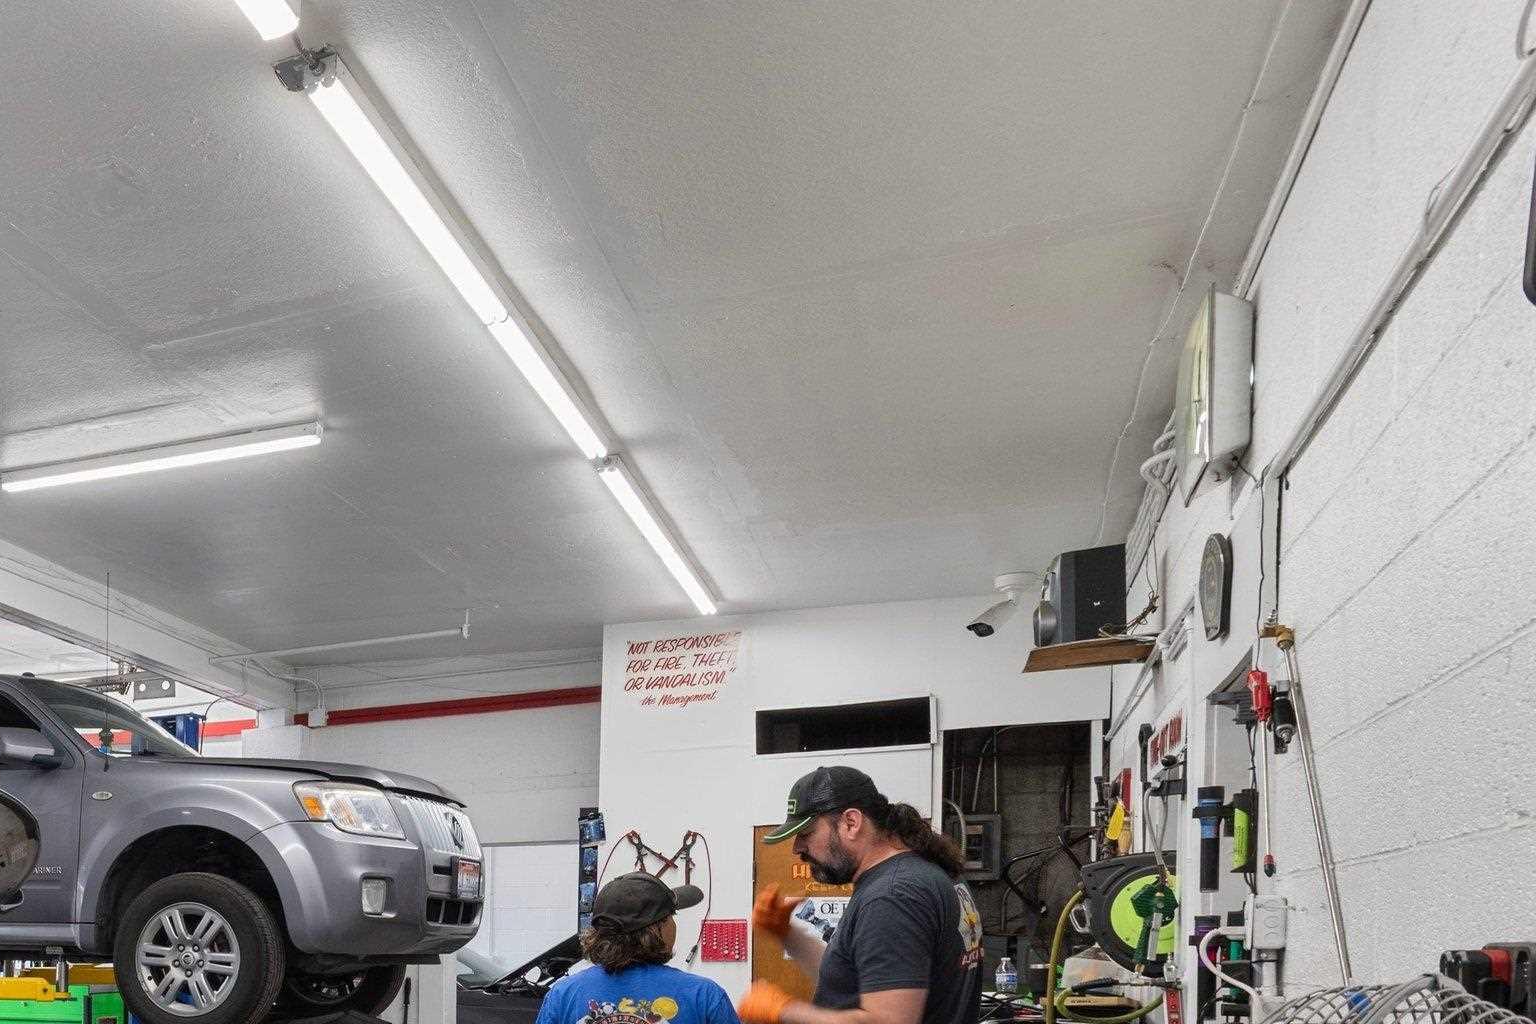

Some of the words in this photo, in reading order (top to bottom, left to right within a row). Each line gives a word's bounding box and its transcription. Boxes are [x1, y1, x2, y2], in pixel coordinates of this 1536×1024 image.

[653, 632, 741, 653] RESPONSIB
[626, 660, 651, 673] FOR
[624, 677, 644, 692] OR
[641, 695, 656, 706] the
[33, 866, 62, 874] ARINER
